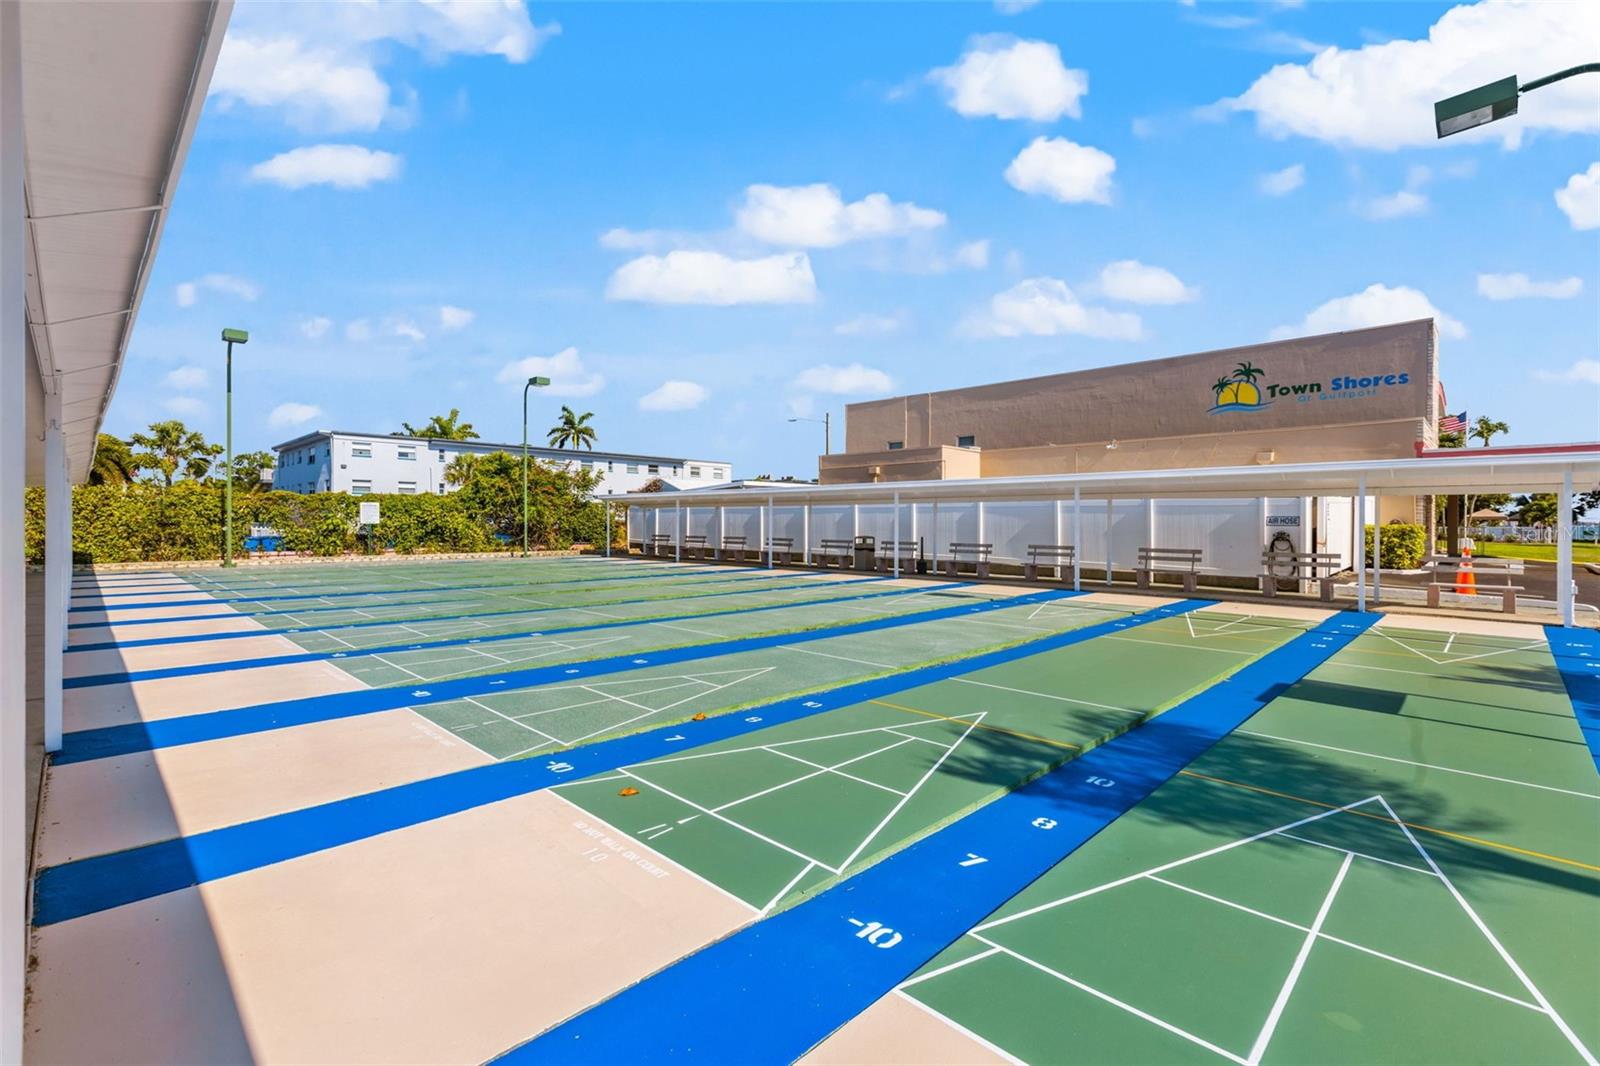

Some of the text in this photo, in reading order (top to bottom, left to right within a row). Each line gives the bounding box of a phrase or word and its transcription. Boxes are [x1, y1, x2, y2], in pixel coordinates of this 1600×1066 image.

[1266, 373, 1409, 398] Town Shores
[1268, 516, 1298, 524] AIR HOSE
[1084, 775, 1116, 788] 10
[1031, 817, 1058, 830] 8
[581, 847, 609, 863] 10
[958, 853, 989, 868] 7
[848, 917, 903, 949] -10
